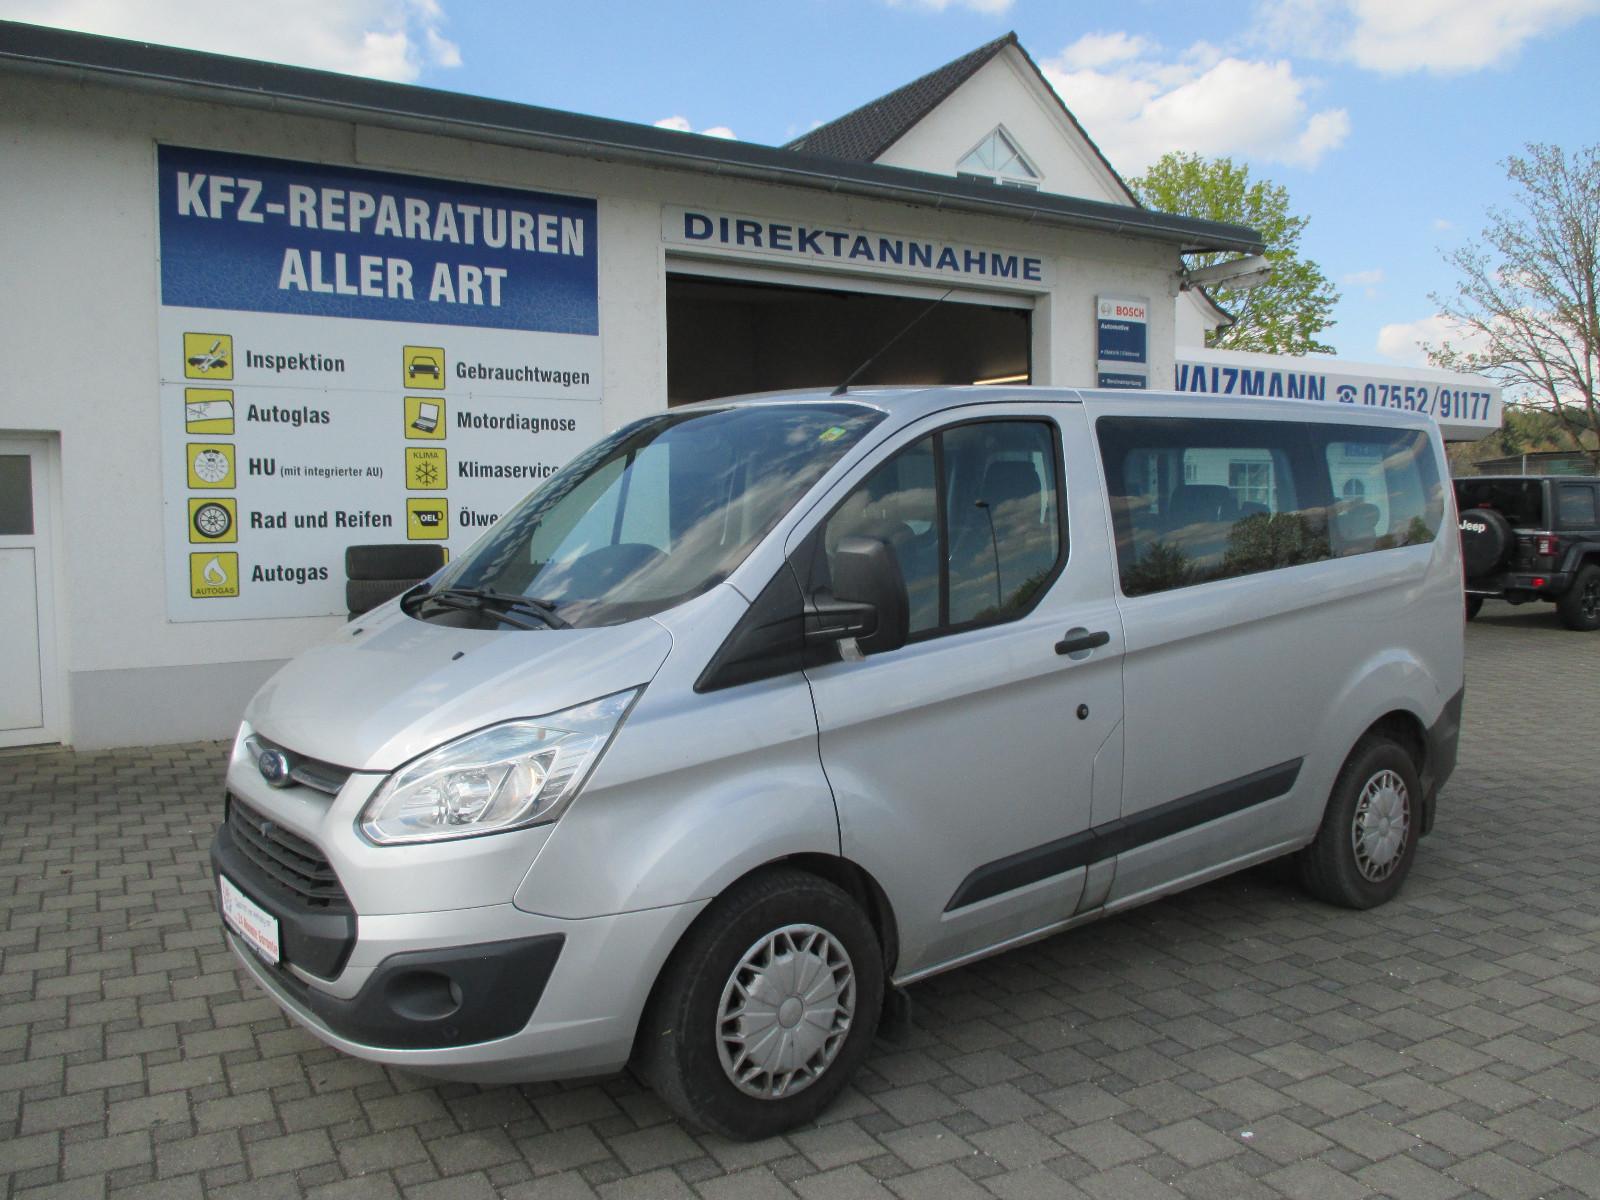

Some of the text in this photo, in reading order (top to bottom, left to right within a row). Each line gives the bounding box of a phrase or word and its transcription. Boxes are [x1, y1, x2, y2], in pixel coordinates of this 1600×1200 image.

[176, 171, 585, 257] KFZ-REPARATUREN
[684, 211, 1042, 282] DIREKTANNAHME
[278, 248, 507, 307] ALLER ART
[1116, 305, 1144, 318] BOSCH
[246, 350, 346, 373] Inspektion
[456, 361, 590, 387] Gebrauchtwagen
[247, 404, 331, 427] Autoglas
[457, 411, 576, 434] Motordiagnose
[413, 451, 439, 459] KLIMA
[249, 457, 383, 479] HU (mit integrierter AU)
[250, 510, 393, 529] Rad und Reifen
[420, 514, 438, 522] OEL
[459, 506, 503, 527] Ölwe
[1459, 519, 1487, 534] Jeep
[251, 564, 329, 585] Autogas
[195, 586, 235, 595] AUTOGAS
